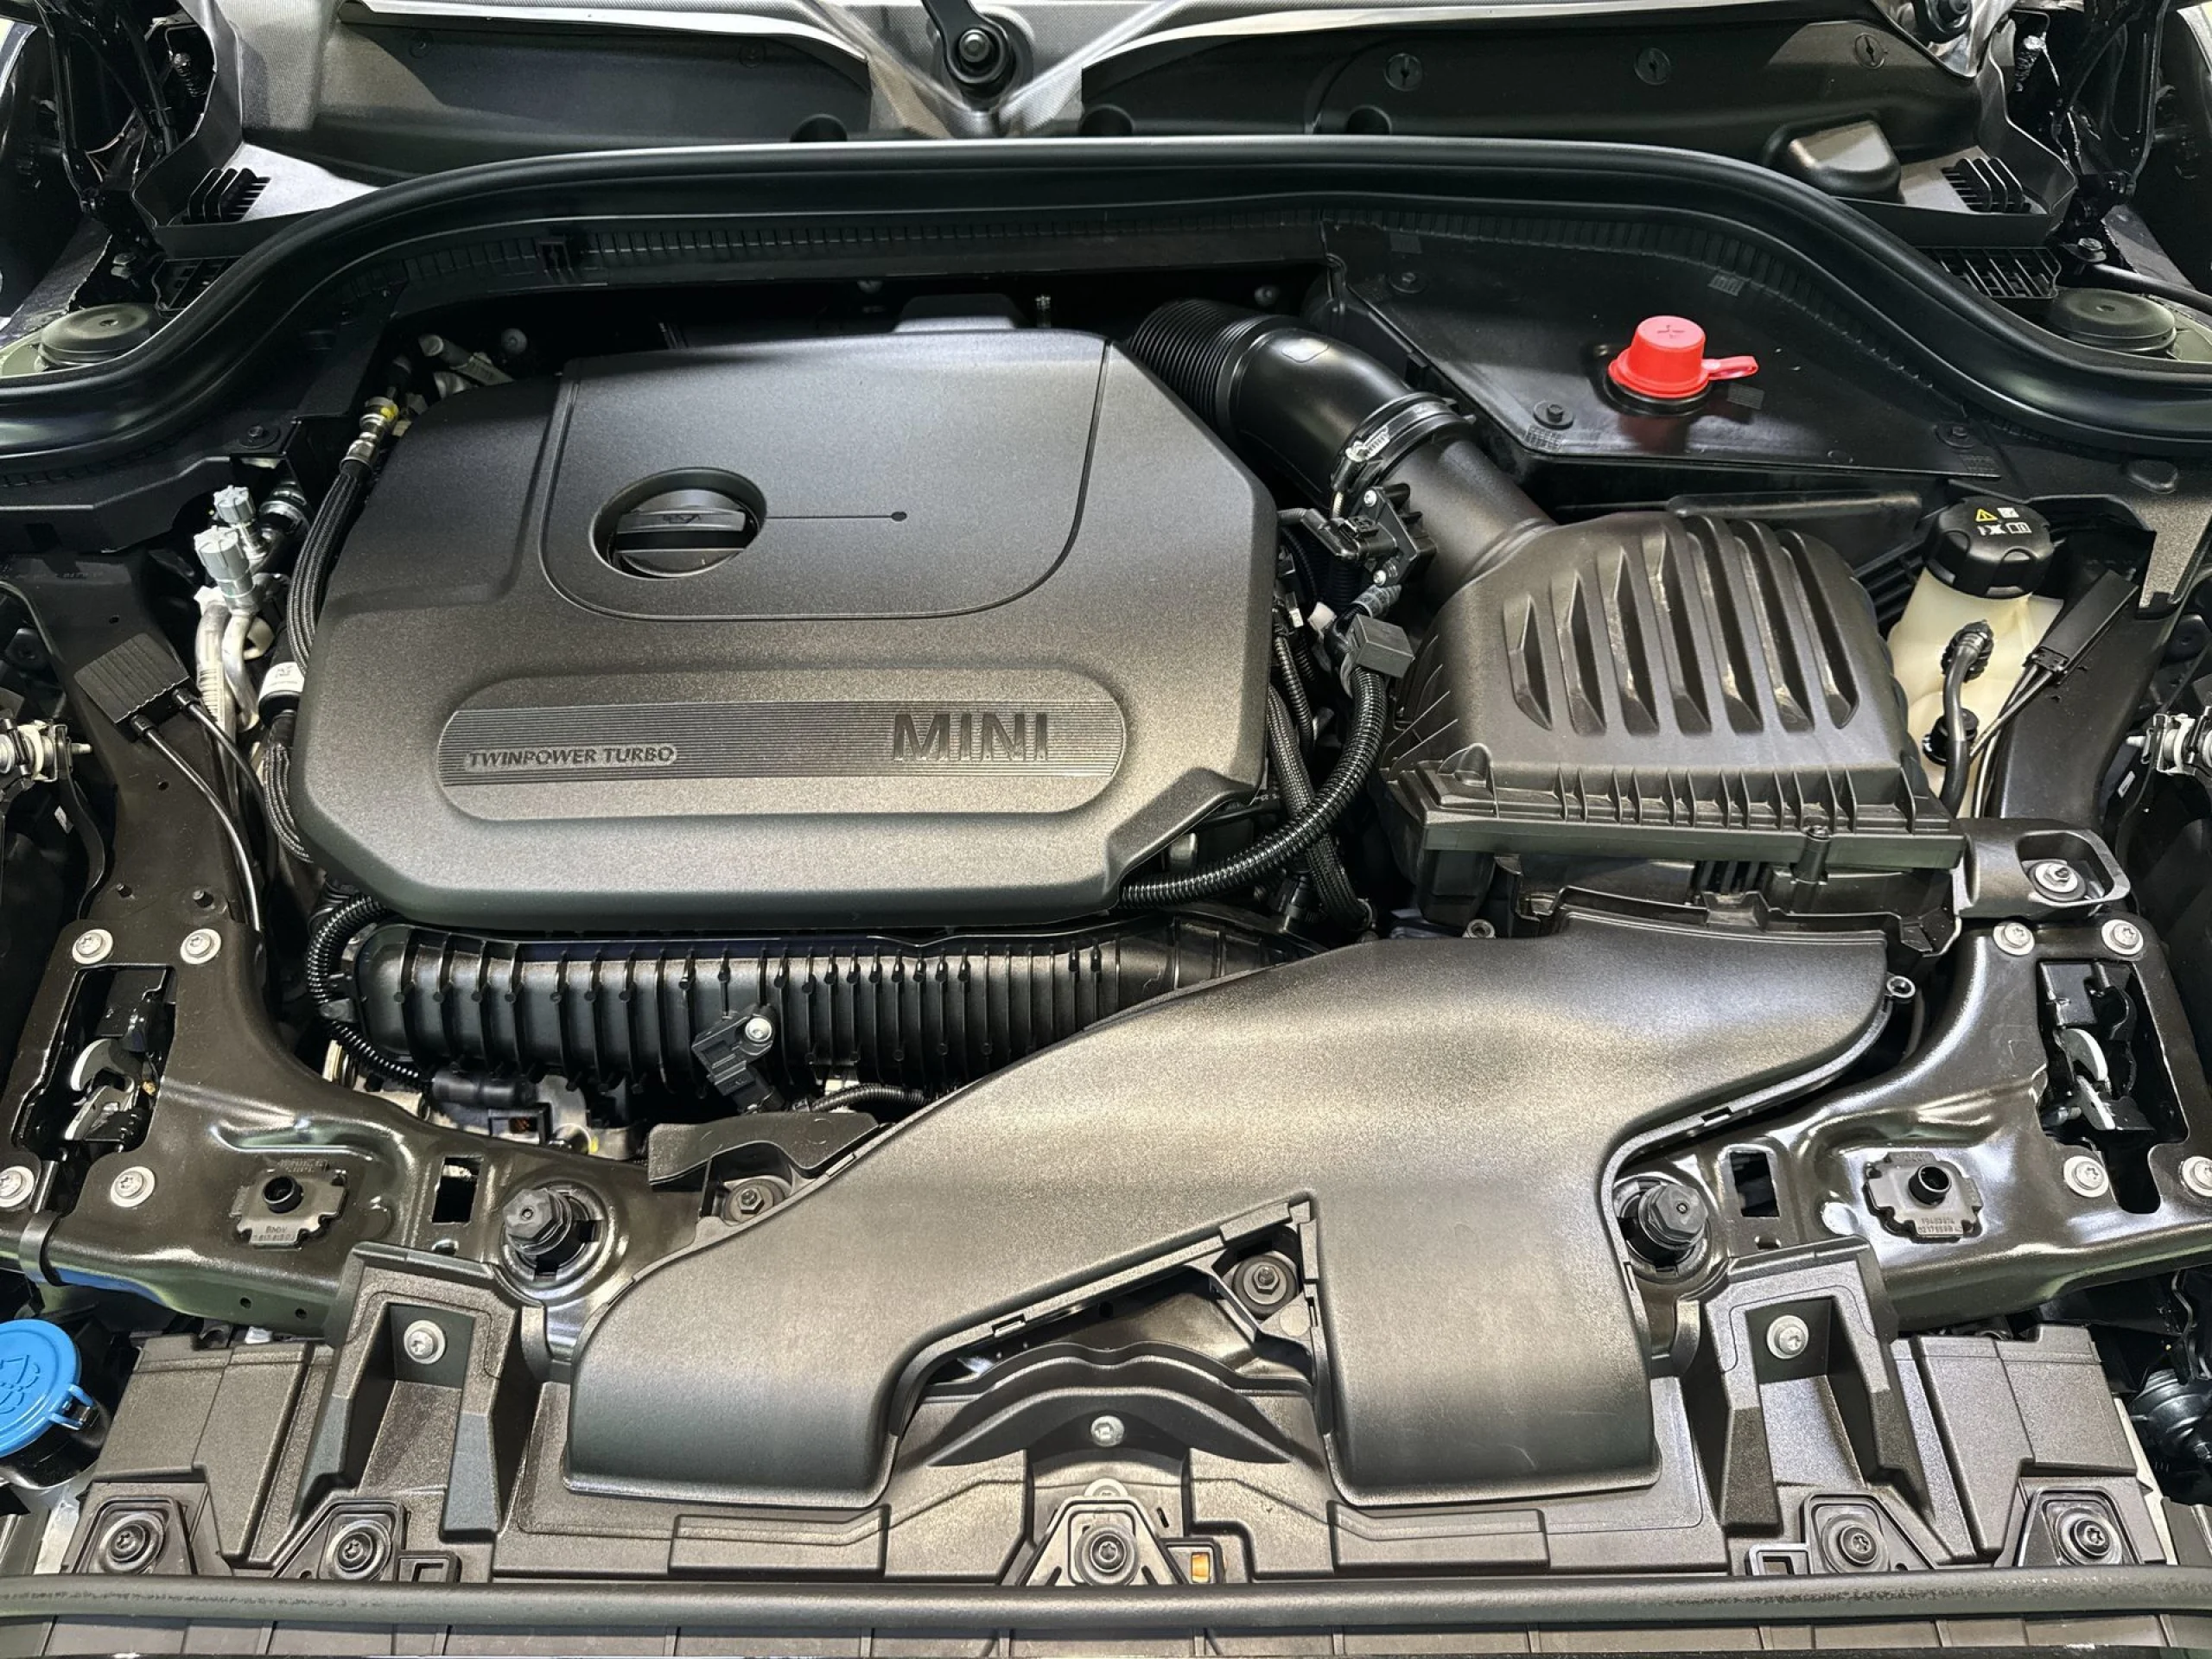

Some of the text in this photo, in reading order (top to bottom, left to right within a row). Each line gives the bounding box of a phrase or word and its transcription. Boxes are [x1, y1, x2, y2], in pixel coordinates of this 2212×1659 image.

[893, 713, 1048, 761] MINI
[469, 746, 675, 766] TWINPOWER TURBO
